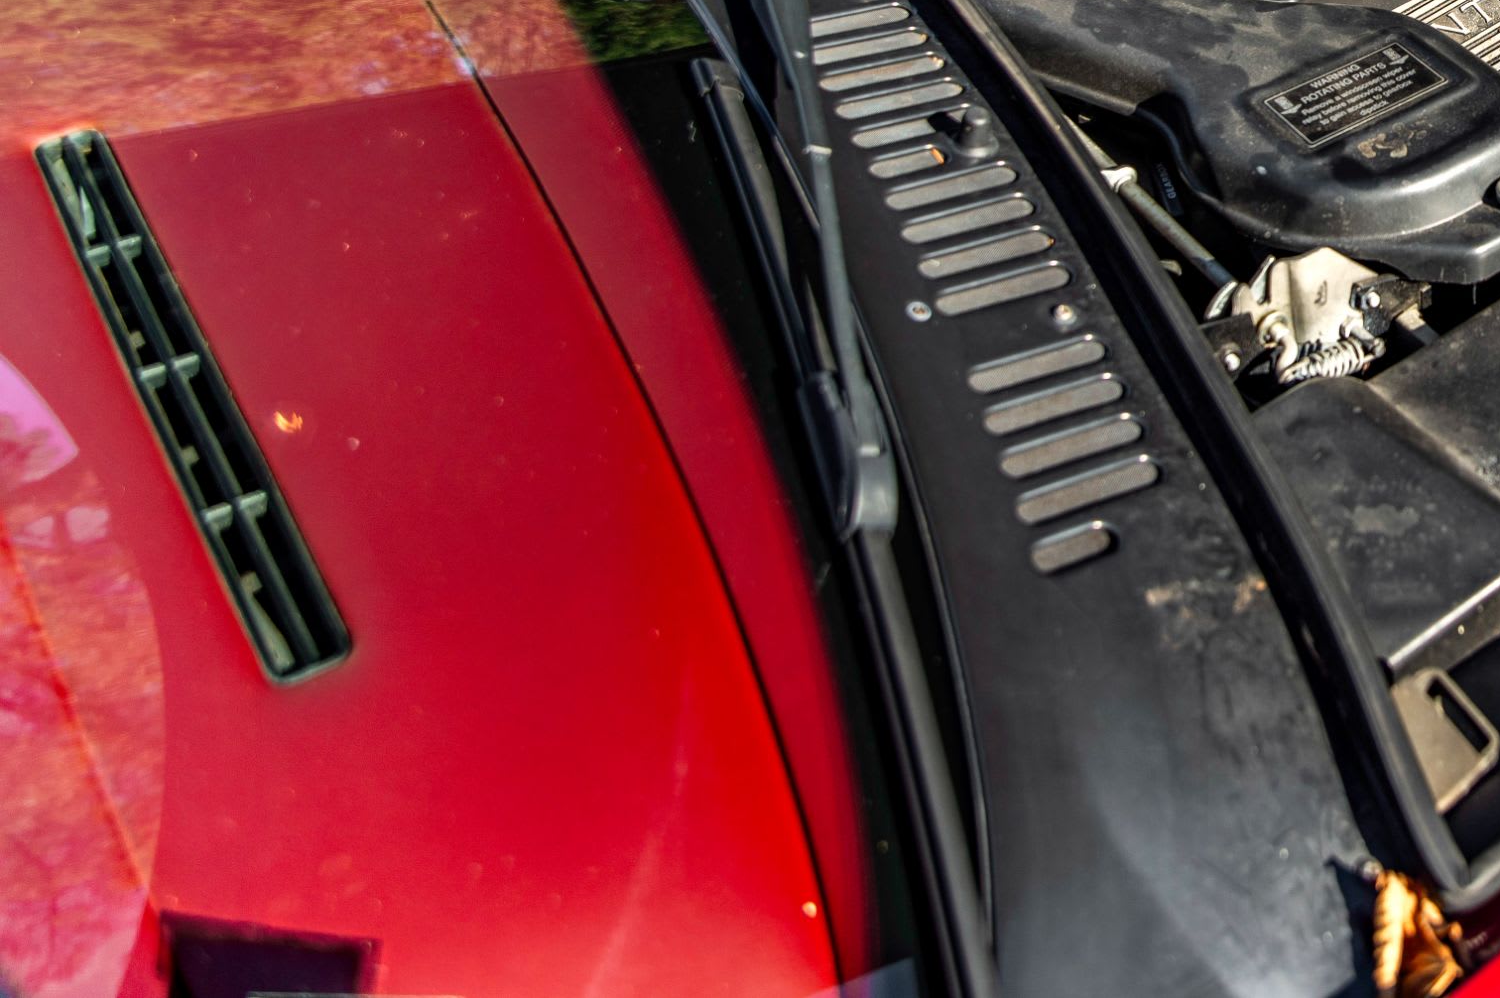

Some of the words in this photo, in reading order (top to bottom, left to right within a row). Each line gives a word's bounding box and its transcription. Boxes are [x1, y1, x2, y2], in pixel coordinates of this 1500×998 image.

[1300, 77, 1354, 104] ROTATING
[1353, 62, 1387, 81] PARTS
[1301, 98, 1336, 115] Remove
[1341, 75, 1383, 97] windscreen
[1381, 66, 1404, 79] wiper
[1309, 63, 1361, 89] WARNING
[1301, 112, 1323, 125] relay
[1321, 101, 1347, 115] before
[1346, 85, 1383, 104] removing
[1380, 78, 1396, 87] this
[1395, 68, 1417, 81] cover
[1345, 98, 1374, 113] access
[1382, 80, 1413, 97] gearbox
[1359, 99, 1389, 116] dipstick
